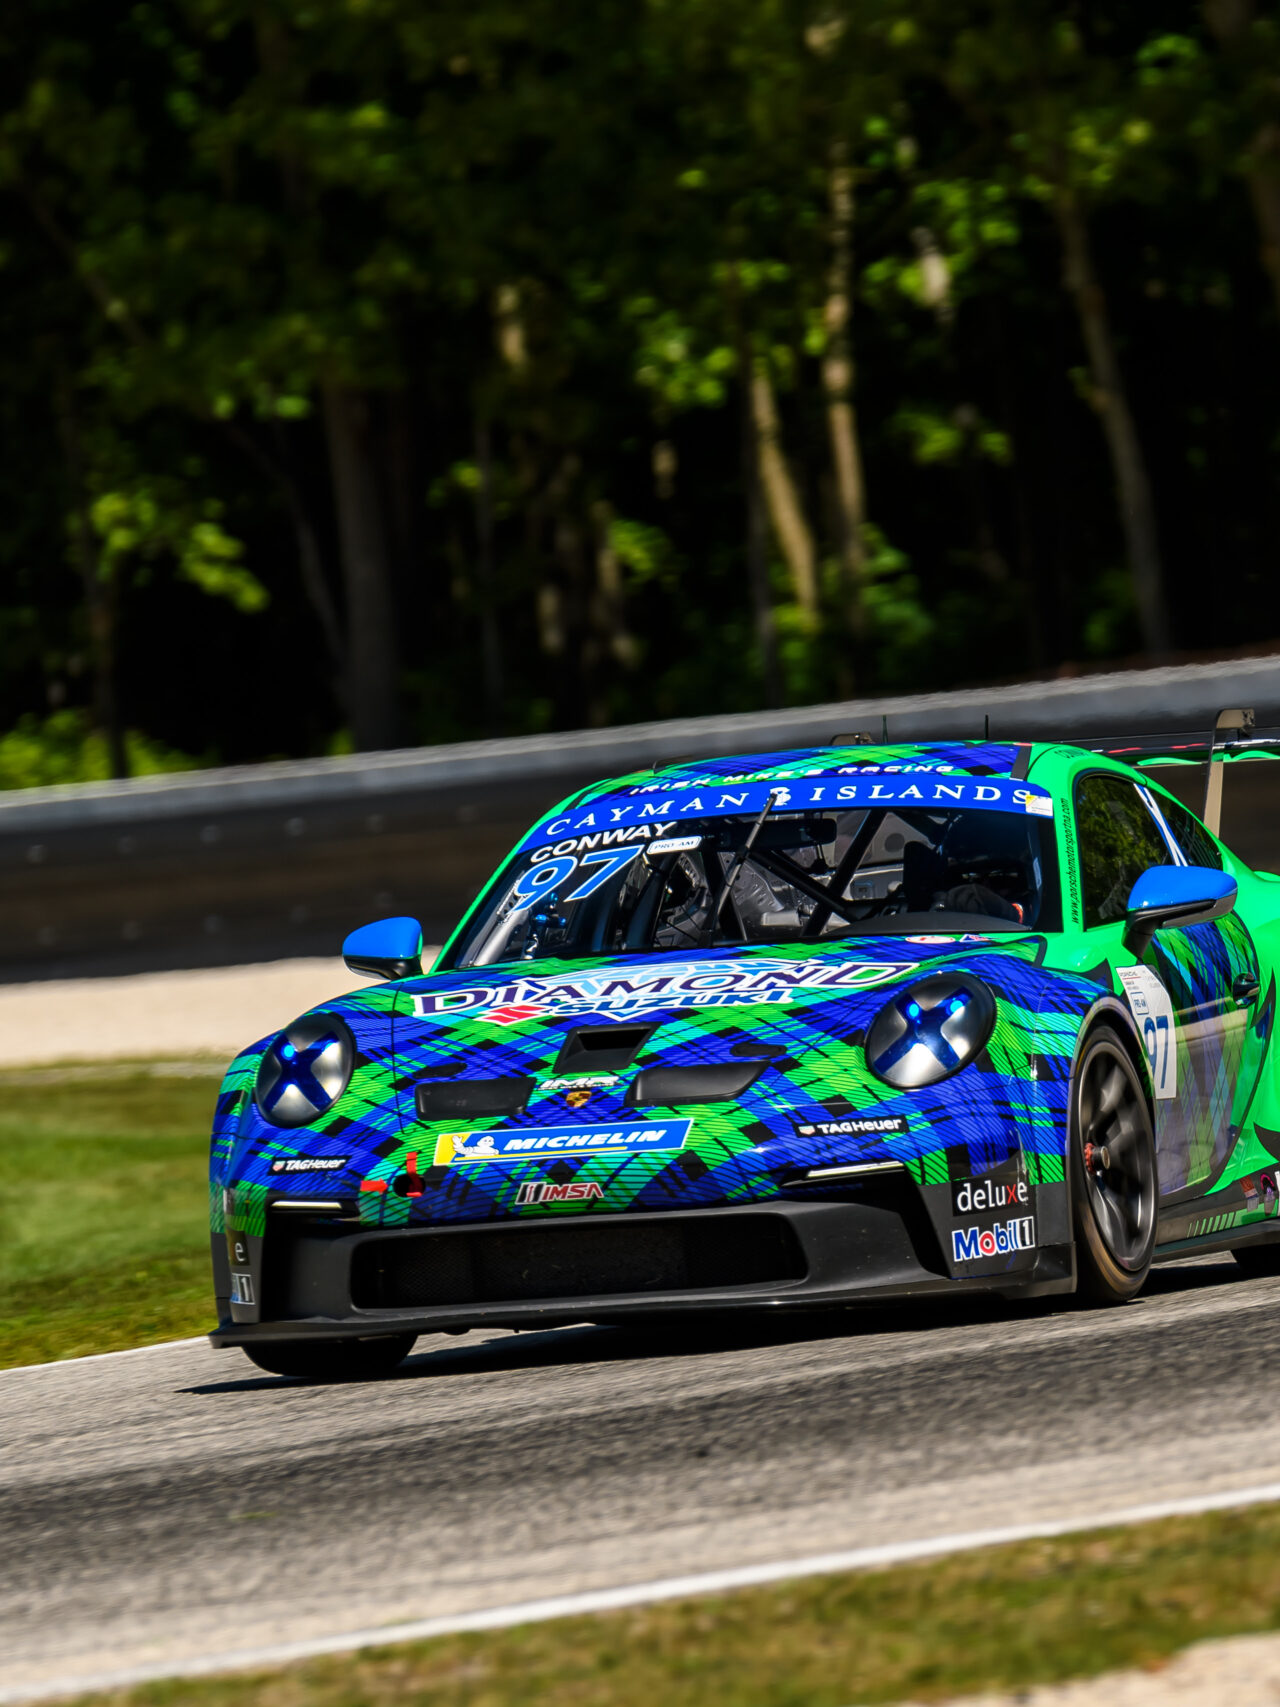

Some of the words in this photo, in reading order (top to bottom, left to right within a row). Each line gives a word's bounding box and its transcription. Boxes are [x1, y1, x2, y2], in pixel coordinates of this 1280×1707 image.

[836, 764, 955, 775] RACING
[545, 792, 750, 836] CAYMAN
[808, 784, 1032, 804] ISLANDS
[530, 821, 678, 863] CONWAY
[503, 844, 646, 917] 97
[412, 962, 920, 1016] DIAMOND
[553, 989, 794, 1016] SUZUKI
[1144, 1014, 1169, 1090] 97
[502, 1129, 668, 1152] MICHELIN
[539, 1182, 604, 1202] IMSA
[956, 1180, 1029, 1212] deluxe
